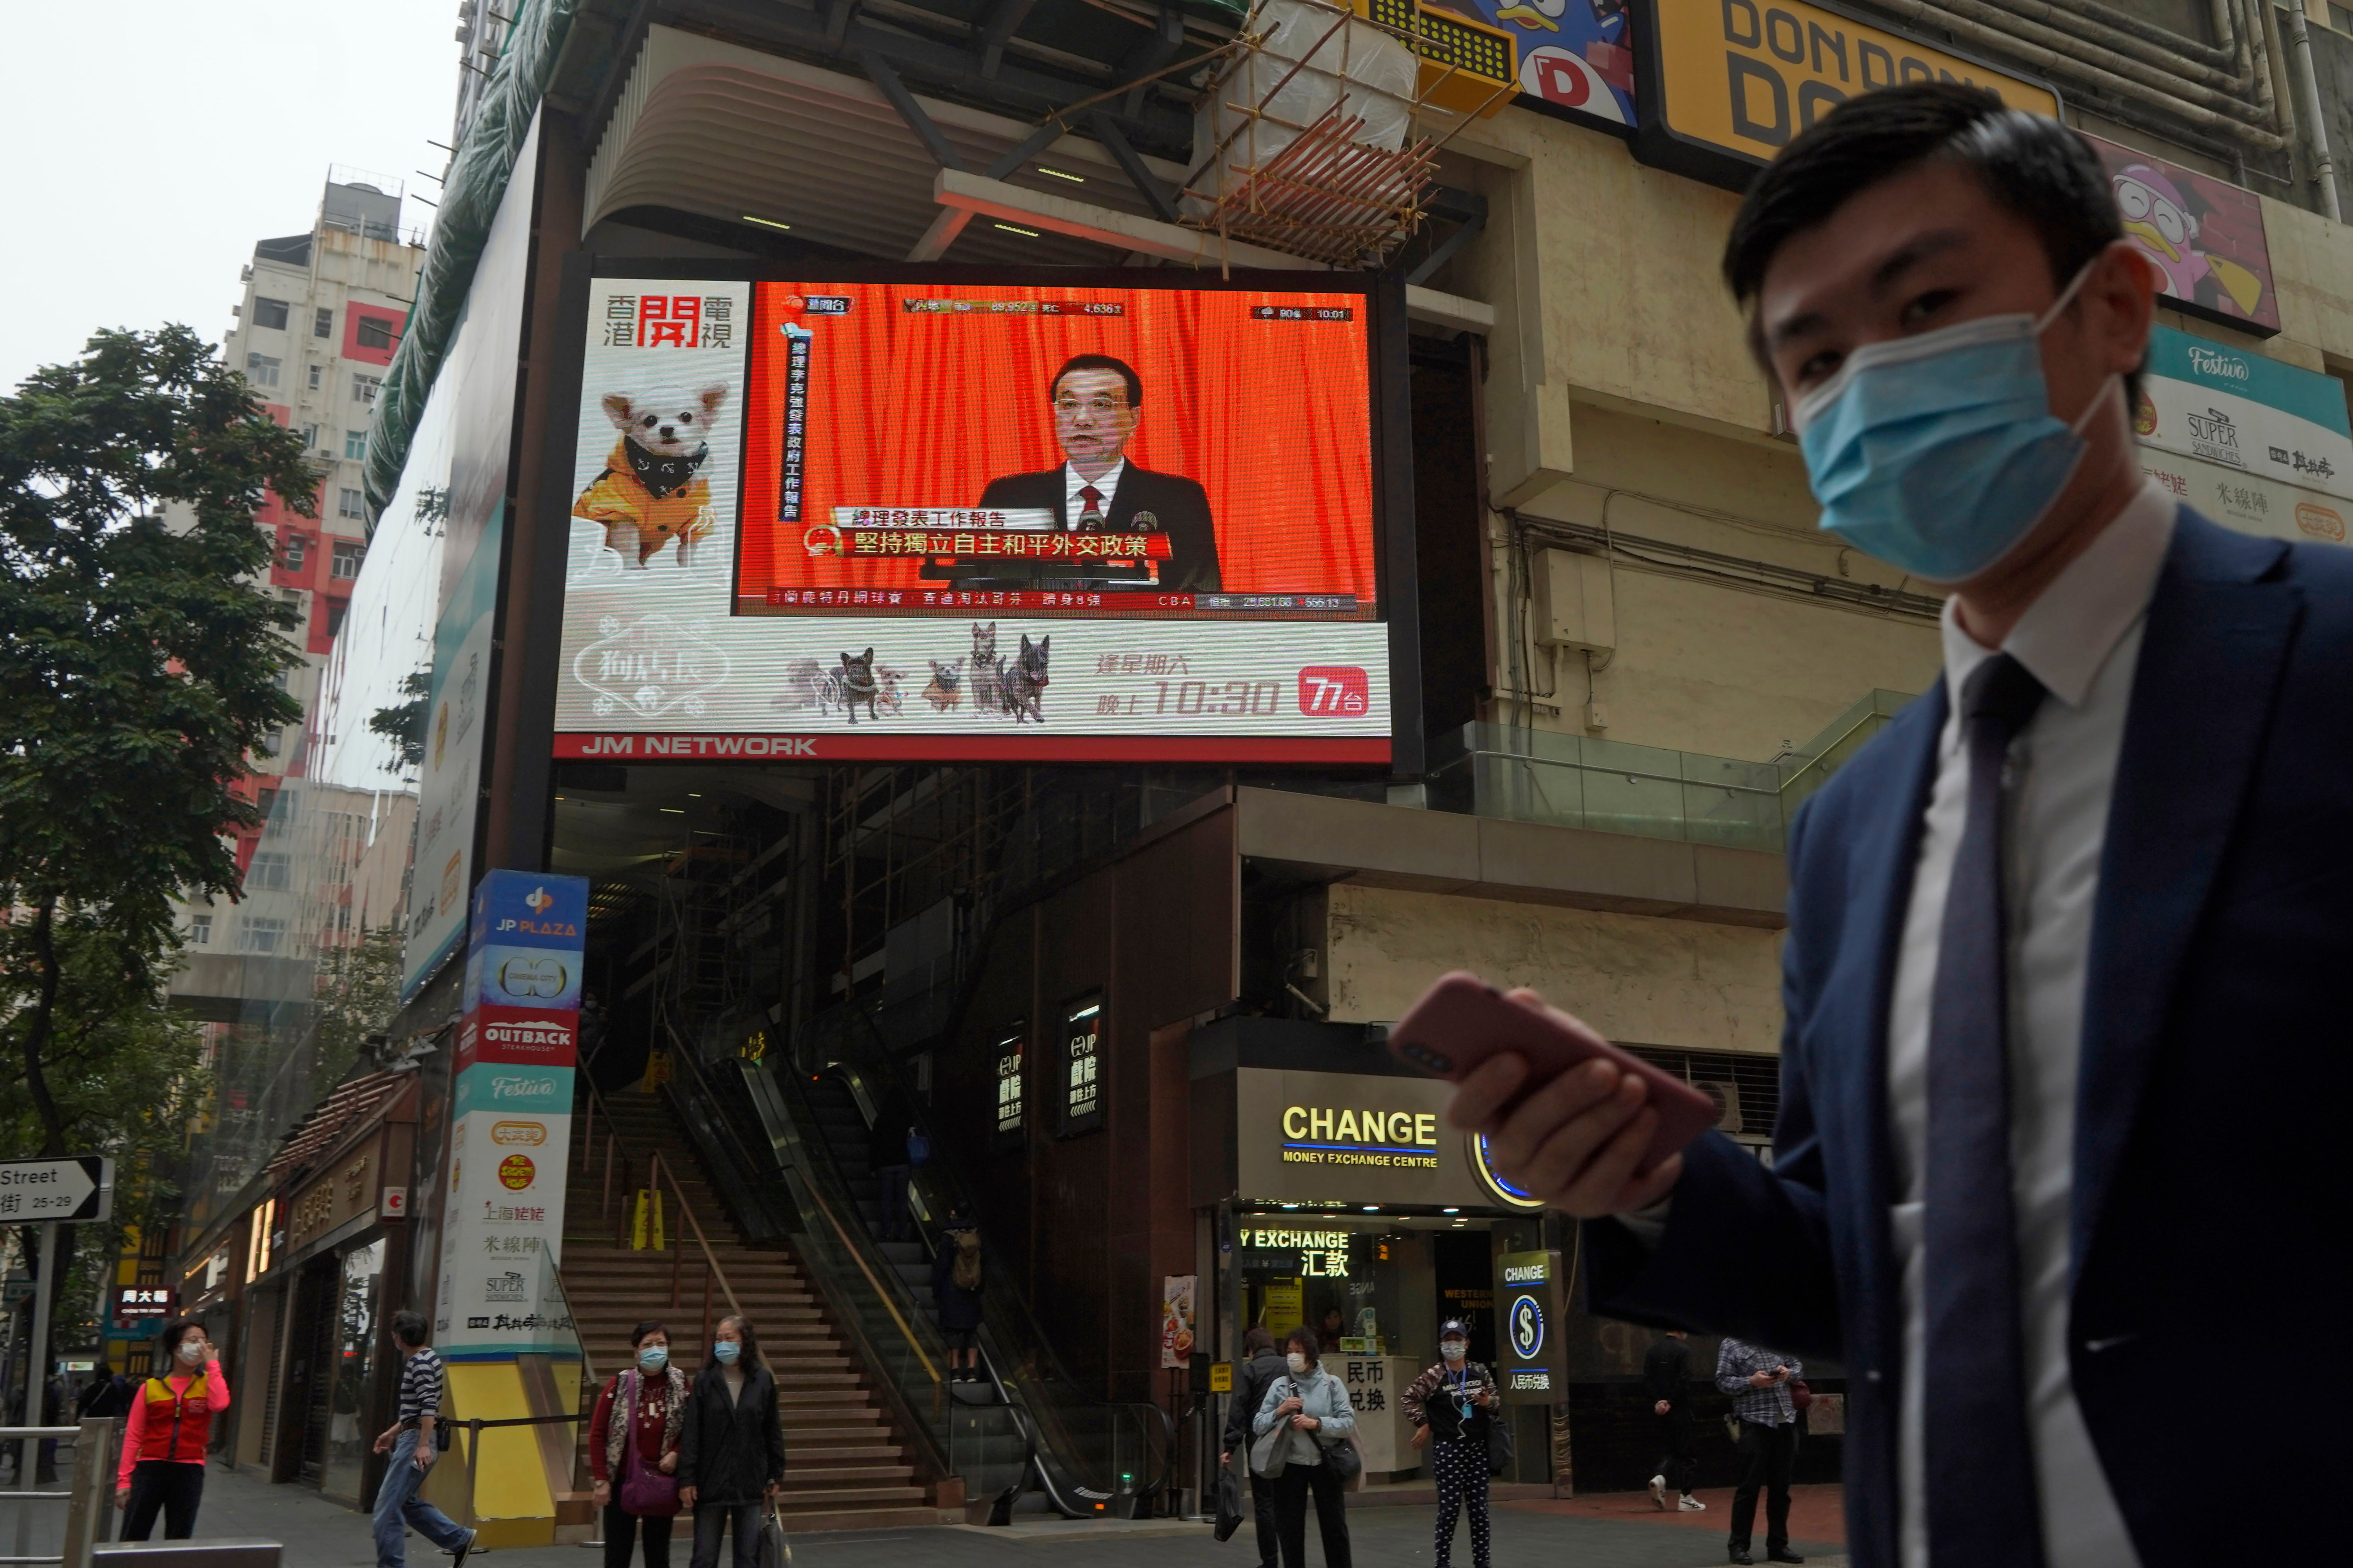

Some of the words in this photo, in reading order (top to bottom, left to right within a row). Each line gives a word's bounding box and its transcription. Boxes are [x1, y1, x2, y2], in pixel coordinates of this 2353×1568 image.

[1722, 0, 1849, 82] DON
[1533, 55, 1590, 106] D
[2188, 347, 2249, 381] Festiva
[2188, 416, 2238, 448] SUPER
[2192, 441, 2241, 464] SANDWICHES
[2216, 482, 2269, 515] 米線陣
[853, 509, 1006, 527] 總理發表工作報告
[855, 531, 1148, 558] 堅持獨立自主和平外交政策
[1158, 596, 1191, 605] CBA
[1095, 653, 1191, 676] 逢星期六
[1095, 694, 1143, 716] 晚上
[1154, 680, 1281, 715] 10:30
[582, 736, 630, 754] JM
[644, 737, 818, 756] NETWORK
[496, 919, 516, 932] JP
[520, 920, 577, 937] PLAZA
[485, 1028, 571, 1045] OUTBACK
[1085, 1033, 1096, 1053] JP
[1011, 1054, 1021, 1072] JP
[1071, 1056, 1096, 1087] 戲院
[491, 1077, 557, 1099] Festiva
[1283, 1106, 1437, 1146] CHANGE
[1283, 1151, 1325, 1163] MONEY
[1328, 1153, 1391, 1166] EXCHANGE
[1393, 1156, 1438, 1168] CENTRE
[0, 1168, 58, 1185] Street
[0, 1194, 22, 1214] 街
[32, 1196, 72, 1208] 25-29
[483, 1205, 546, 1221] 上海姥姥
[483, 1236, 540, 1254] 米線陣
[1255, 1229, 1349, 1248] EXCHANGE
[1301, 1249, 1349, 1277] 汇款
[1505, 1265, 1544, 1282] CHANGE
[486, 1280, 524, 1292] SUPER
[1444, 1289, 1493, 1299] WESTERN
[122, 1290, 169, 1303] 周大福
[1461, 1300, 1495, 1309] UNION
[1347, 1361, 1383, 1384] 民币
[1510, 1374, 1550, 1390] 人民币兑换
[1349, 1388, 1386, 1411] 兑换
